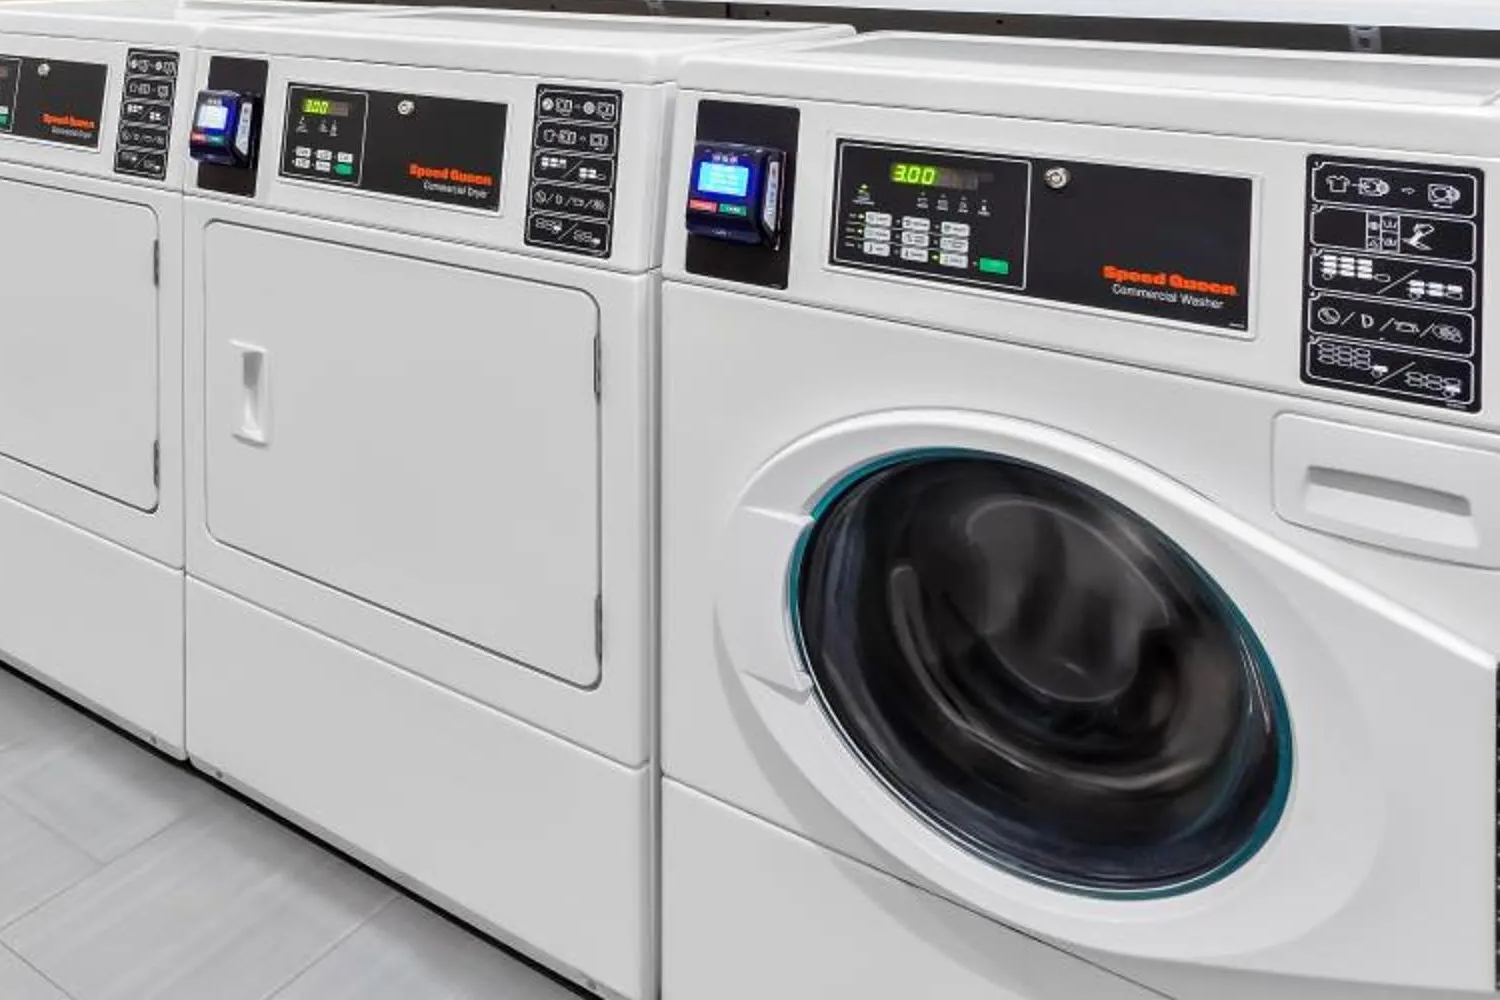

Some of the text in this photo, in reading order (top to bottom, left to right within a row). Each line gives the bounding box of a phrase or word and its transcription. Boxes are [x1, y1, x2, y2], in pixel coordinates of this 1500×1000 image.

[409, 163, 492, 186] Speed Queen
[1103, 265, 1237, 295] Speed Queen
[1112, 283, 1224, 309] Commercial Washer
